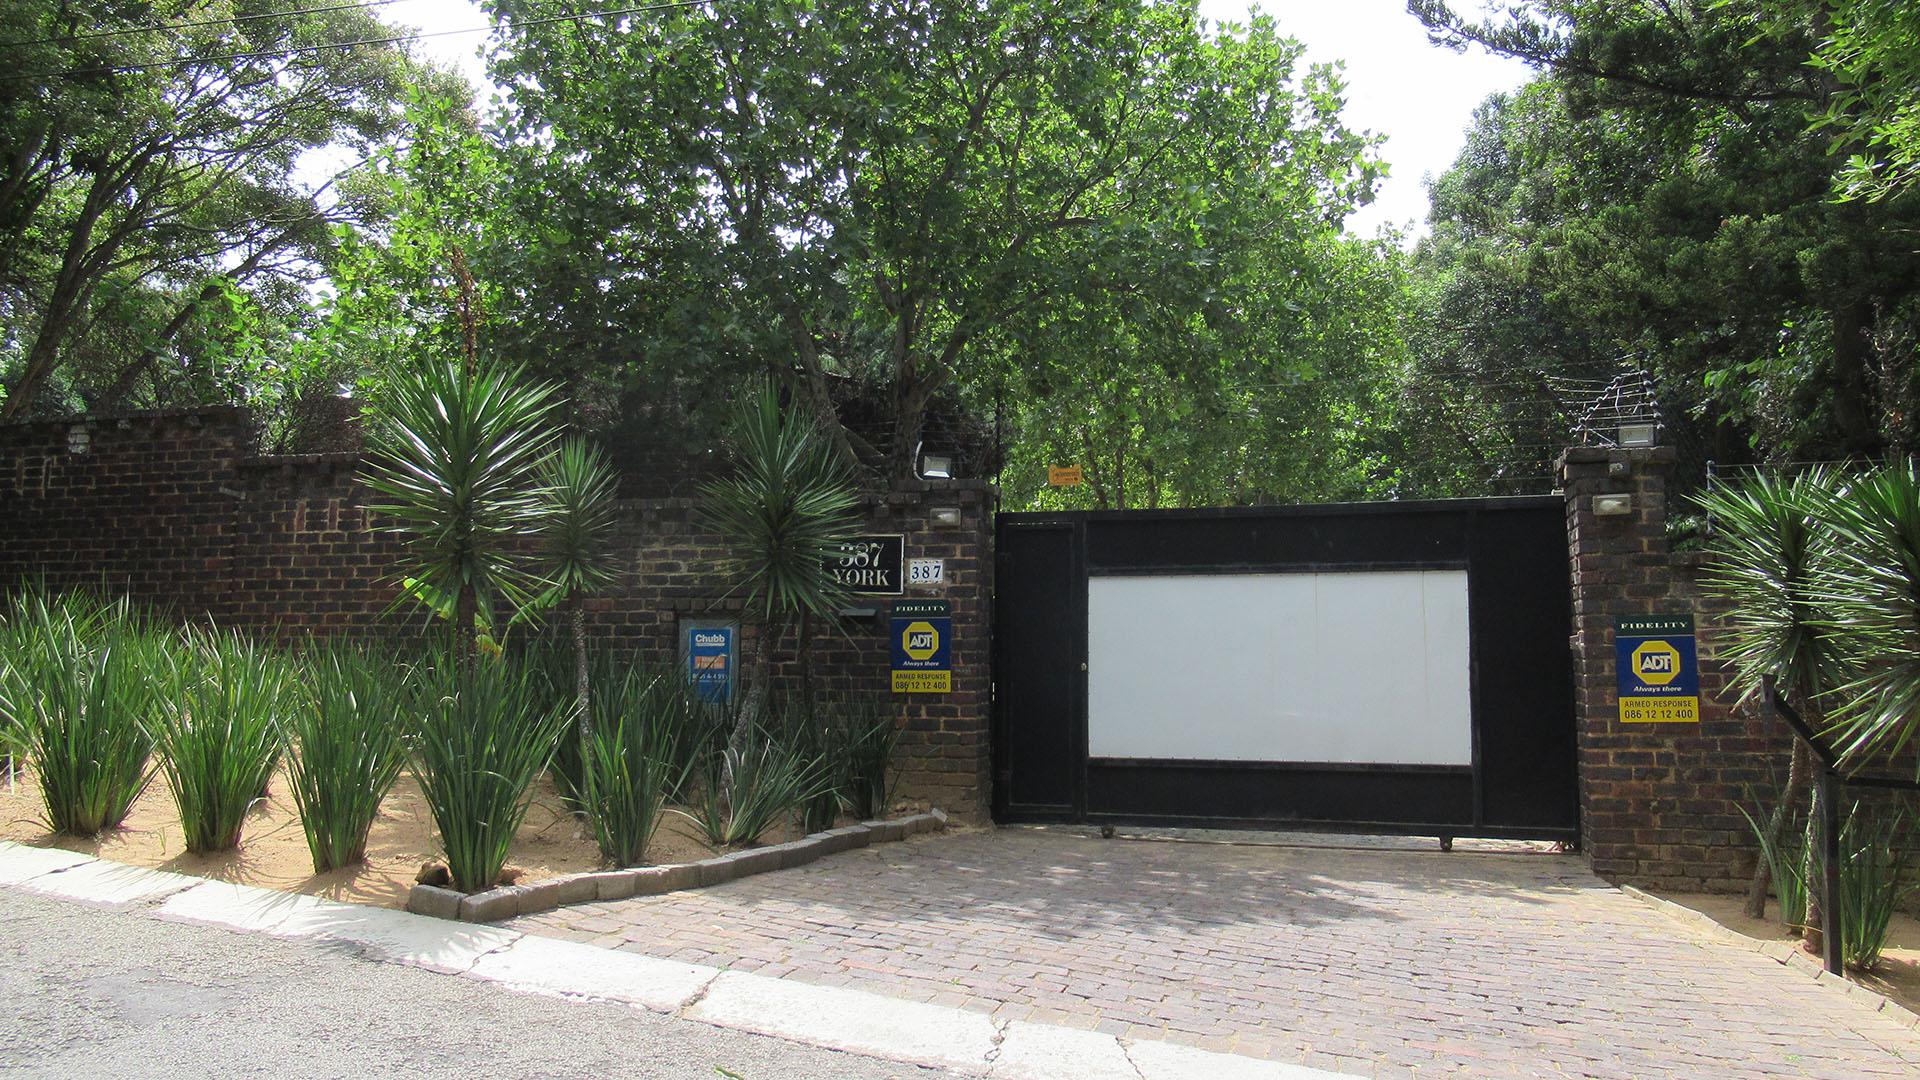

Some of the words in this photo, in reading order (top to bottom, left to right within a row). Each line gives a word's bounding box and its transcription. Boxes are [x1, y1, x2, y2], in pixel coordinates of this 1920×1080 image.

[840, 543, 884, 567] 387
[833, 569, 890, 586] YORK
[912, 565, 941, 579] 387
[1620, 621, 1688, 629] FIDELITY
[695, 633, 725, 643] Chubb
[909, 634, 933, 648] ADT
[1641, 654, 1672, 670] ADT
[896, 681, 909, 689] 086
[911, 681, 920, 689] 12
[922, 681, 931, 689] 12
[933, 681, 947, 689] 400
[1624, 700, 1651, 708] ARMED
[1653, 700, 1692, 708] RESPONSE
[1624, 709, 1642, 719] 086
[1645, 709, 1657, 718] 12
[1660, 709, 1672, 718] 12
[1674, 709, 1693, 718] 400
